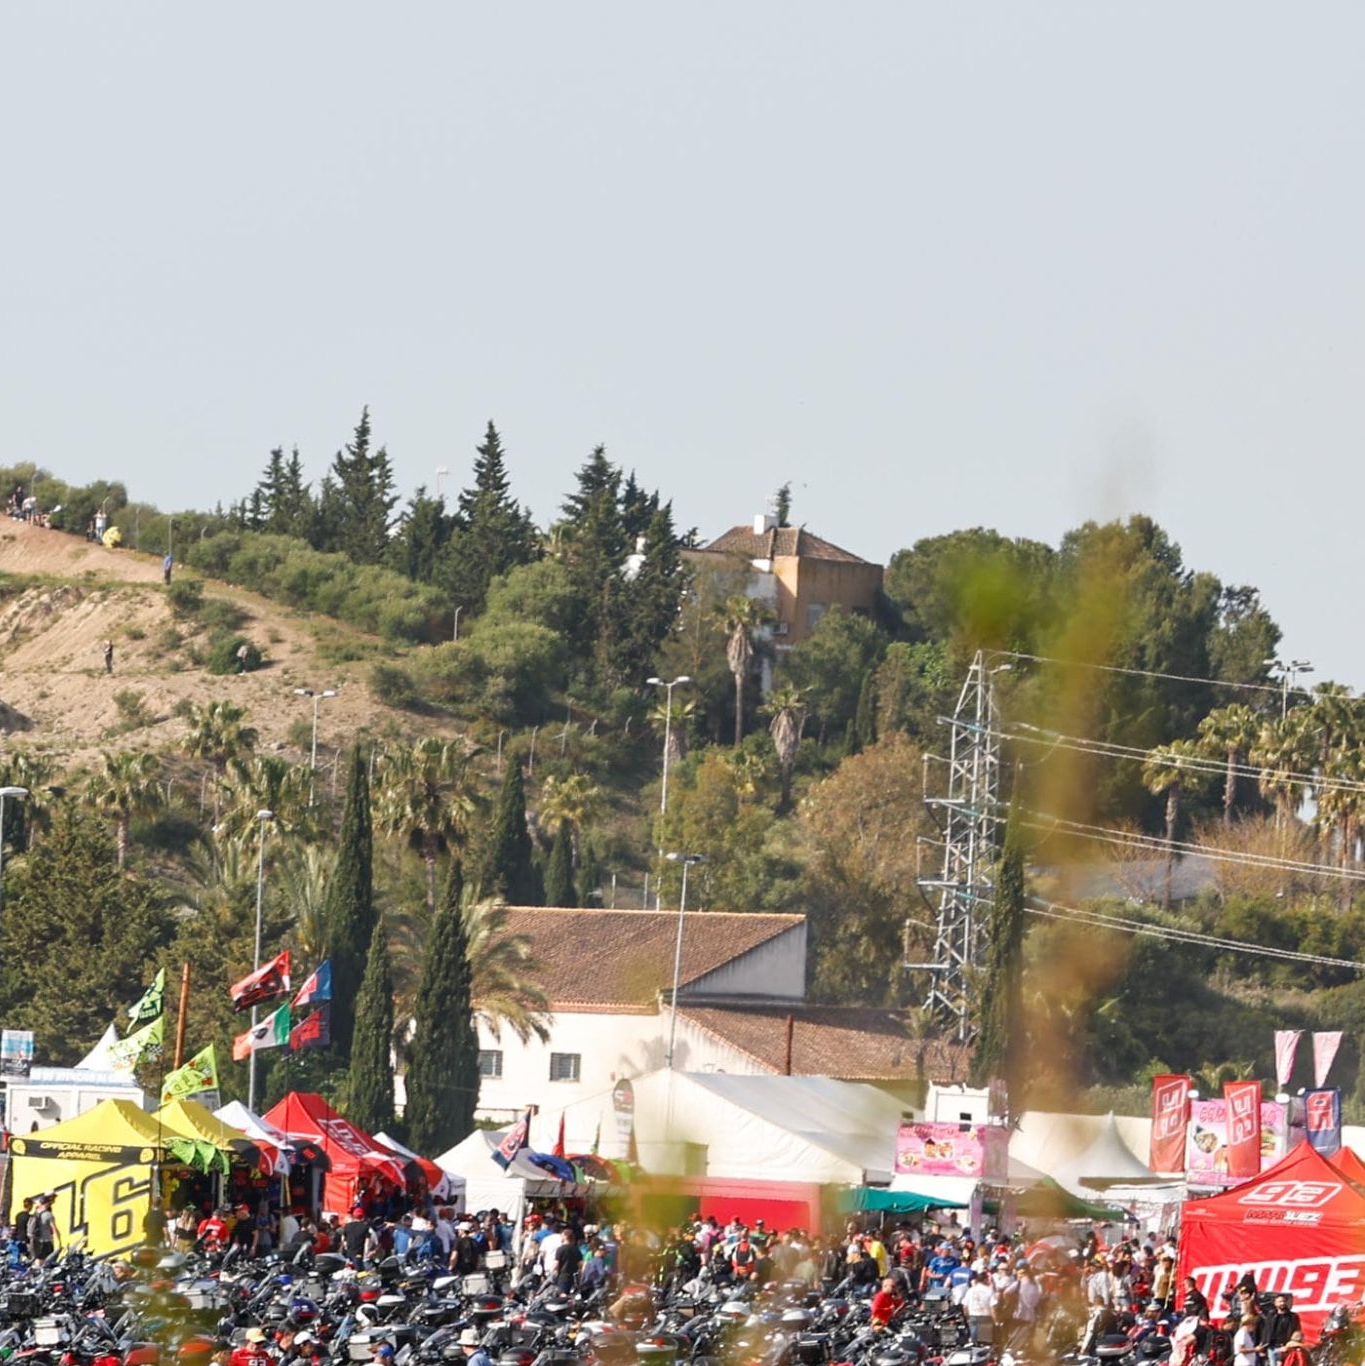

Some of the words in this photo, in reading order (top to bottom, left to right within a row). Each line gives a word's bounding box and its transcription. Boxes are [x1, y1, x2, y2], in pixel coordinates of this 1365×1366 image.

[40, 1142, 82, 1151] OFFICIAL
[84, 1144, 122, 1153] RACING
[57, 1152, 102, 1160] APPAREL
